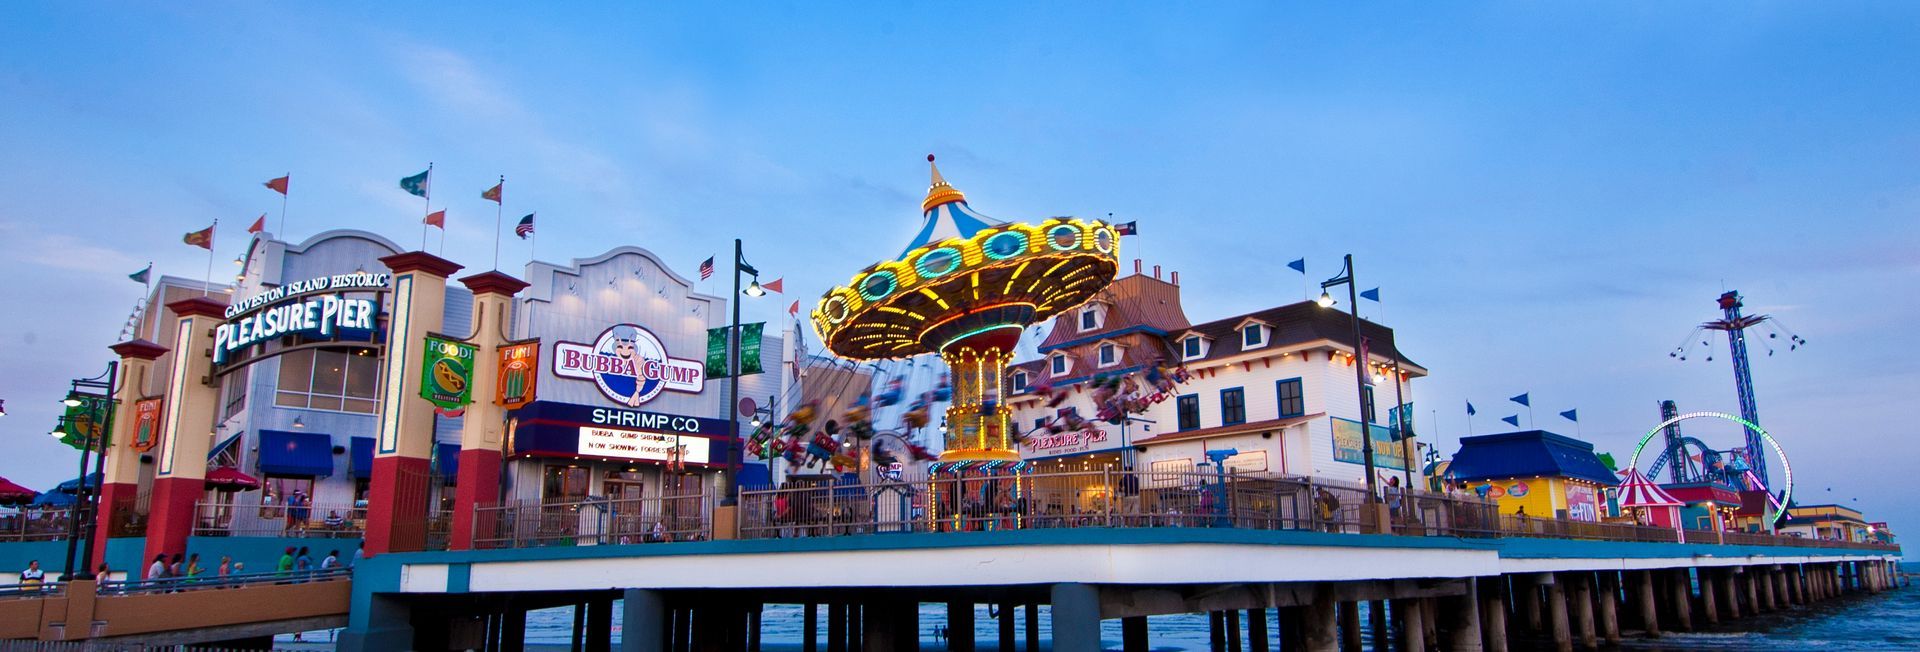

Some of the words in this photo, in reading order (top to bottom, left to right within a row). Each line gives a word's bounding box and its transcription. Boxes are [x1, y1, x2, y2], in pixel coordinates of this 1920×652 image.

[225, 287, 284, 318] GALVESTON
[288, 276, 328, 295] ISLAND
[330, 273, 389, 288] HISTORIC
[213, 301, 319, 364] PLEASURE
[321, 294, 375, 335] PIER
[430, 341, 472, 359] FOOD!
[505, 346, 531, 360] FUN!
[563, 349, 638, 376] BUBBA
[644, 360, 700, 384] GUMP
[140, 402, 157, 412] FUN!
[593, 408, 668, 429] SHRIMP
[592, 429, 614, 438] BUBBA
[620, 432, 638, 440] GUMP
[1032, 433, 1079, 453] PLEASURE
[609, 444, 638, 452] SHOWING
[1376, 441, 1390, 456] NOW
[1578, 502, 1596, 522] FUN
